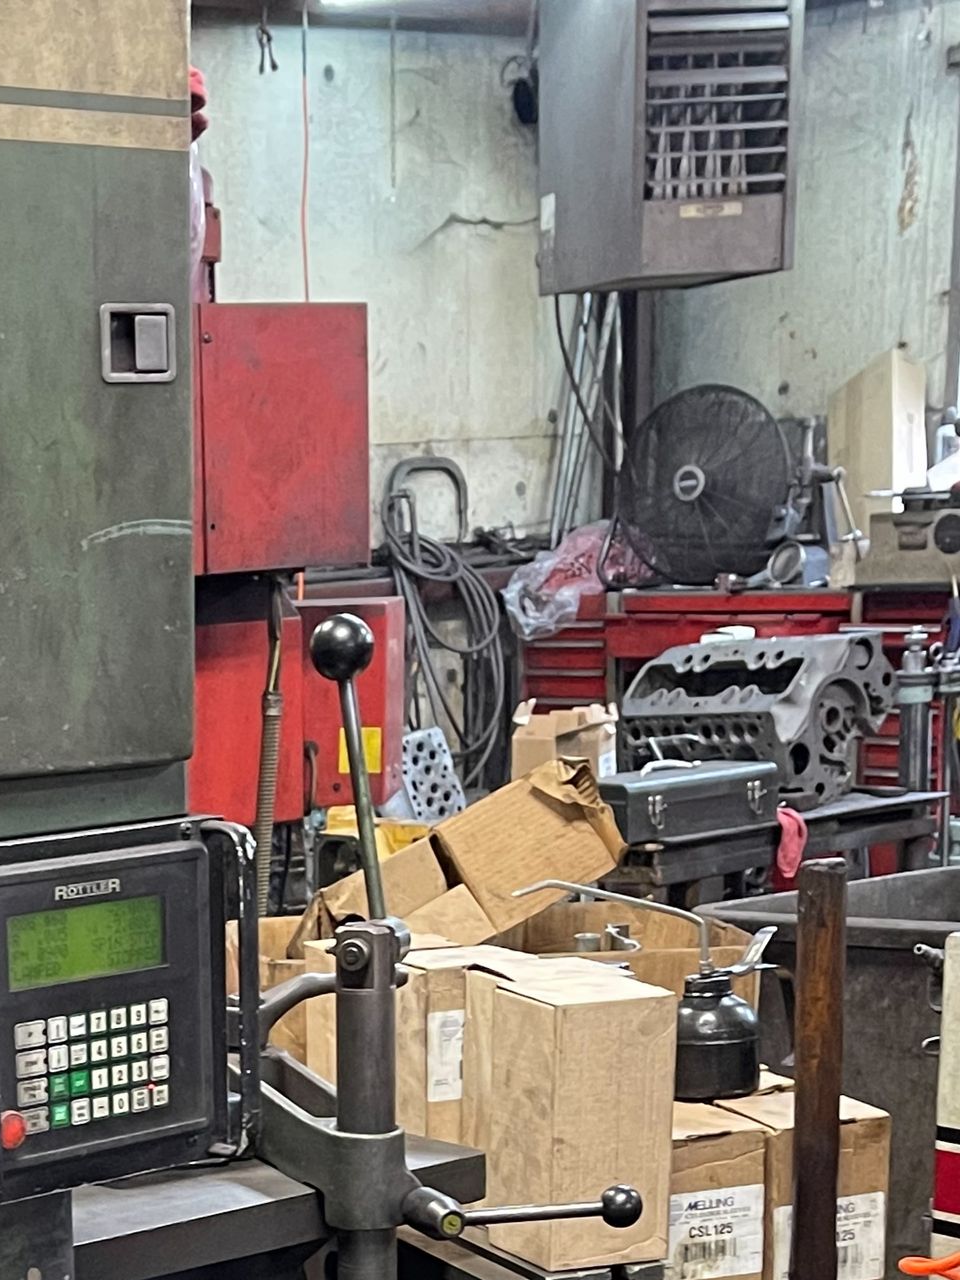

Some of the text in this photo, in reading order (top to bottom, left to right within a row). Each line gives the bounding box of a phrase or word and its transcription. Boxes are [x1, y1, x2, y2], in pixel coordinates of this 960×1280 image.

[55, 879, 120, 901] ROTTLER
[95, 1016, 102, 1030] 7
[115, 1013, 122, 1025] 8
[135, 1010, 142, 1021] 9
[96, 1045, 103, 1057] 4
[116, 1041, 123, 1053] 5
[136, 1038, 143, 1049] 6
[117, 1069, 124, 1081] 2
[136, 1066, 143, 1077] 3
[117, 1098, 124, 1110] 0
[685, 1196, 734, 1212] MELLING
